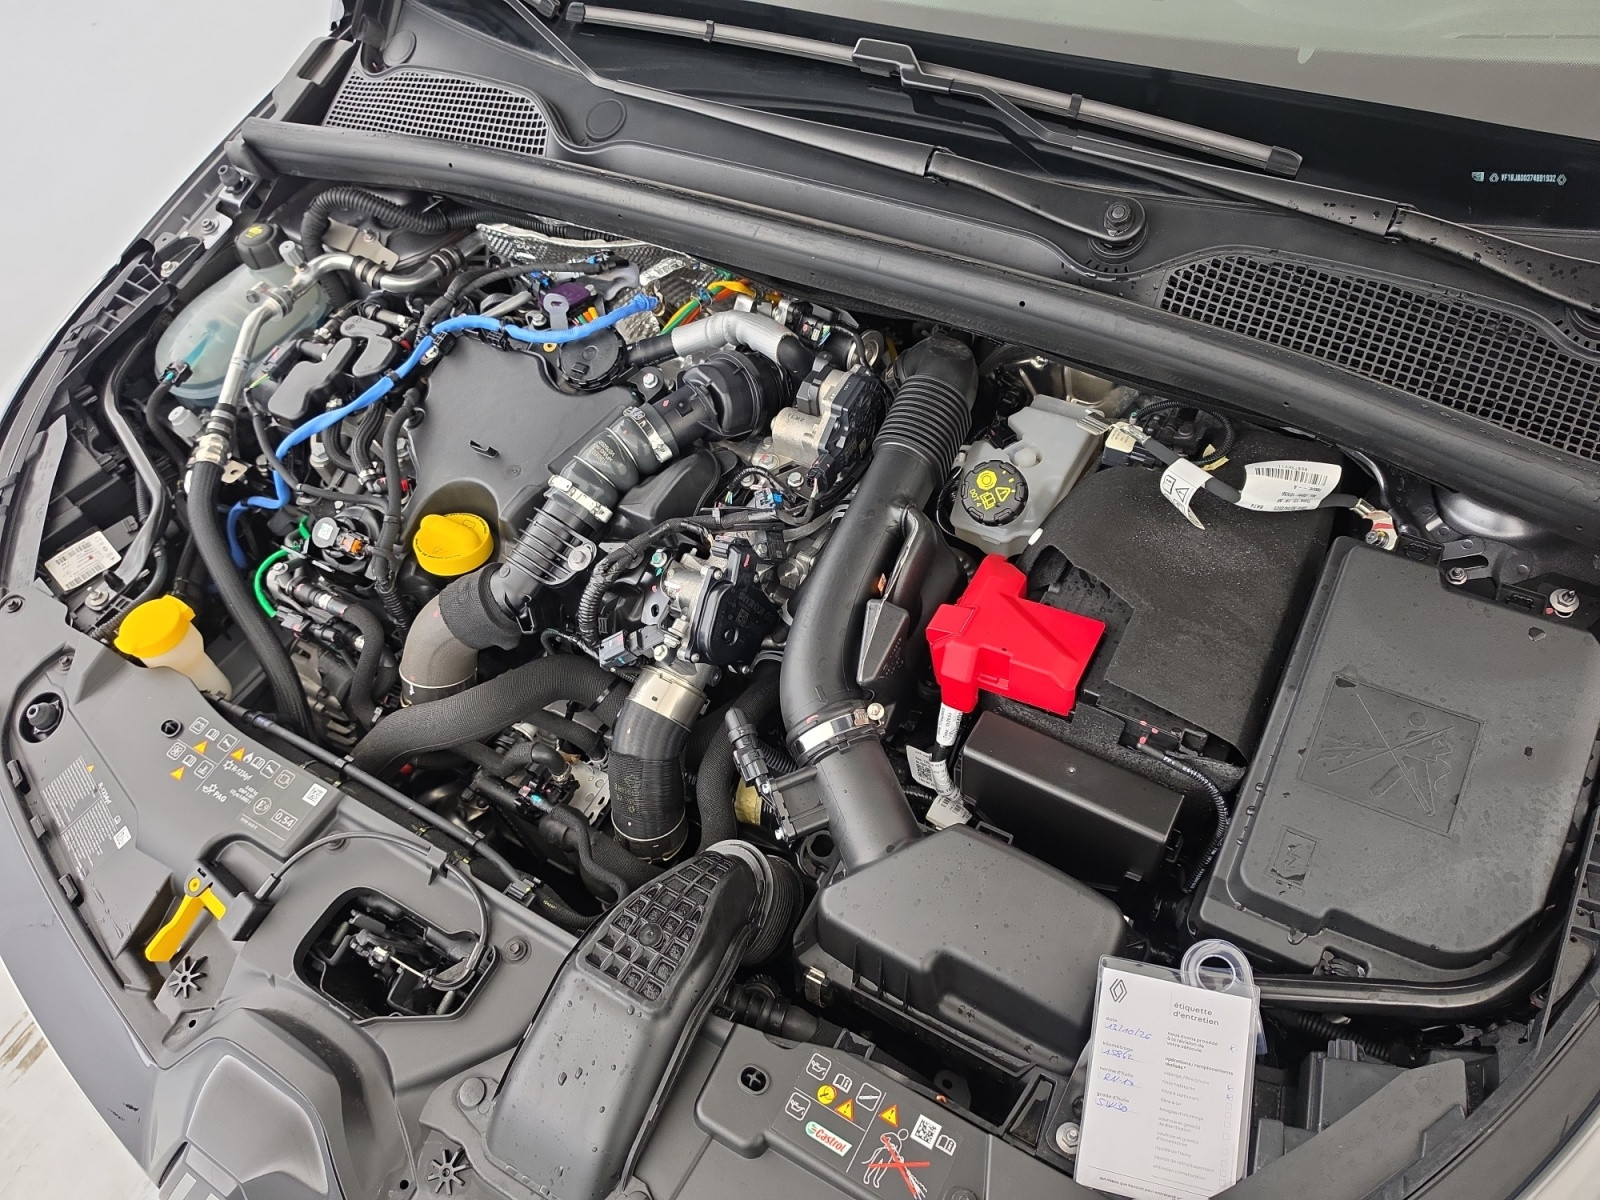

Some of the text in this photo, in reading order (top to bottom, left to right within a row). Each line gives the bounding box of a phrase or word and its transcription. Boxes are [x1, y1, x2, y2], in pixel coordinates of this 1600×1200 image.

[970, 488, 980, 501] DOT
[212, 791, 227, 803] PAG
[274, 812, 294, 828] 0,54
[1173, 1003, 1213, 1016] étiquette
[1173, 1010, 1220, 1027] d'entretien
[816, 1129, 847, 1153] Castrol
